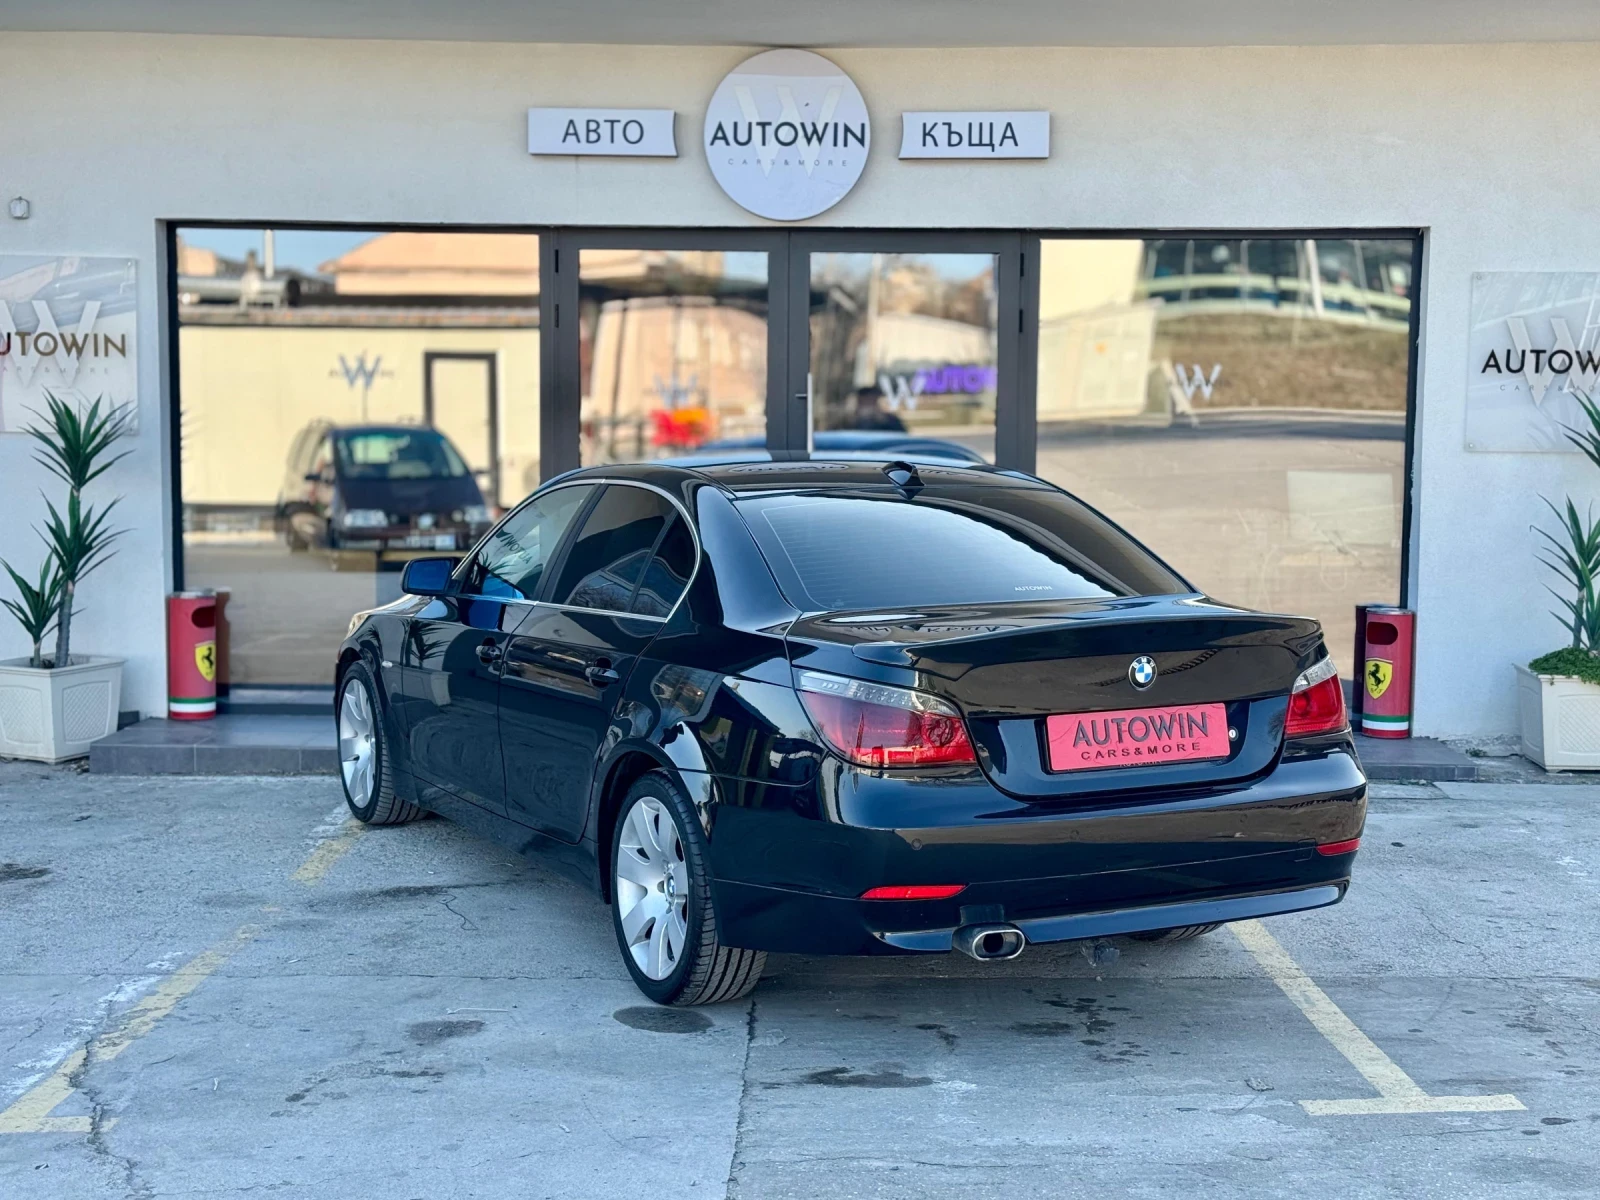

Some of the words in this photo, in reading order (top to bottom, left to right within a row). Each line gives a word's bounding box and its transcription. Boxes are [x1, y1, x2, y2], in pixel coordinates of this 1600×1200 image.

[562, 118, 645, 145] АВТО
[709, 120, 866, 148] AUTOWIN
[922, 121, 1019, 152] КЪЩА
[1073, 711, 1208, 747] AUTOWIN
[1081, 742, 1200, 760] CARS&MORE
